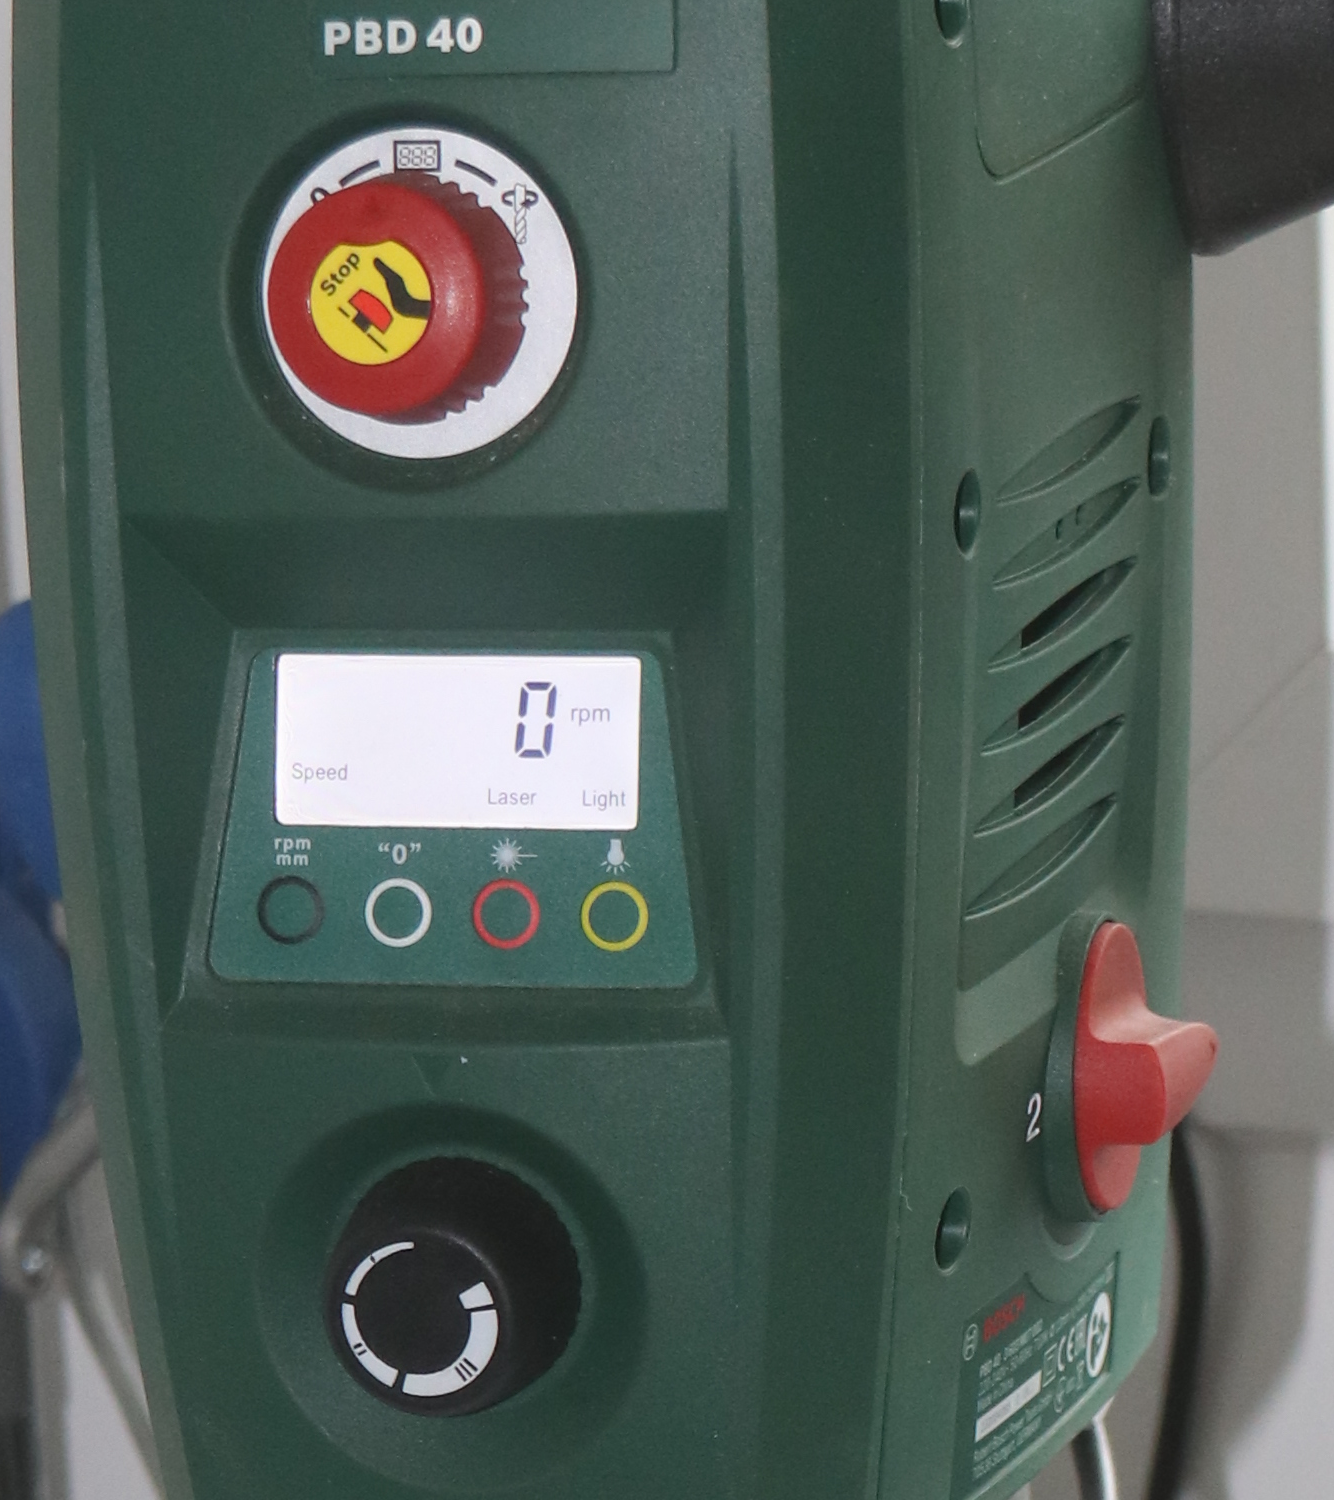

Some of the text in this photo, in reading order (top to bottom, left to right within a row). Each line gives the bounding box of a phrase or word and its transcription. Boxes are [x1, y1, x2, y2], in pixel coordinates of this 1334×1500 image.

[322, 16, 484, 57] PBD 40
[319, 250, 362, 297] Stop
[514, 680, 611, 759] 0 rpm
[291, 761, 349, 784] Speed
[487, 788, 627, 810] Laser Light
[273, 835, 312, 854] rpm
[275, 852, 310, 867] mm
[1025, 1092, 1042, 1143] 2
